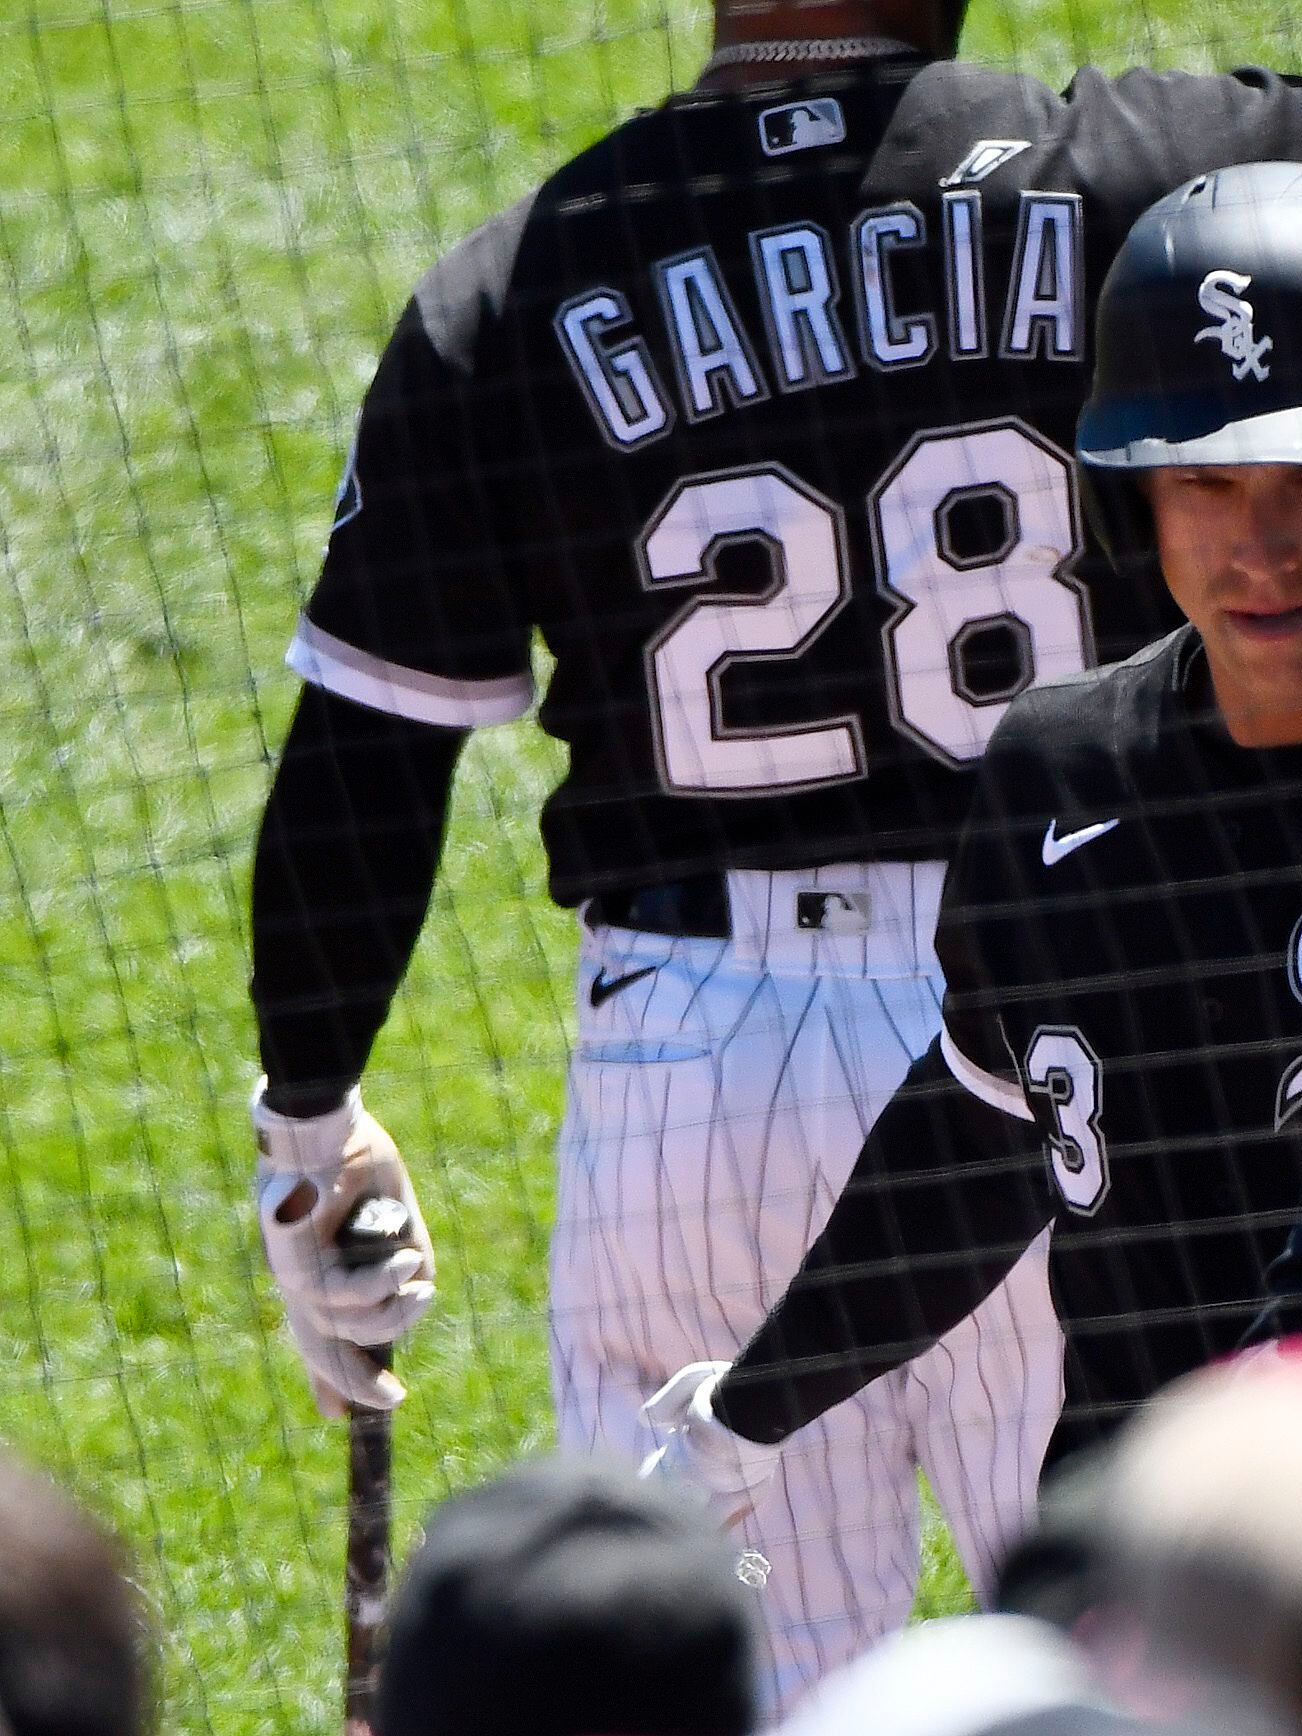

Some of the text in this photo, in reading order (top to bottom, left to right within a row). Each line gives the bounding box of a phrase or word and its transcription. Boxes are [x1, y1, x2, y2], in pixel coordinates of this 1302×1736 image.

[553, 140, 1084, 452] GARCÍA
[633, 414, 1096, 799] 28
[1023, 1024, 1112, 1218] 3
